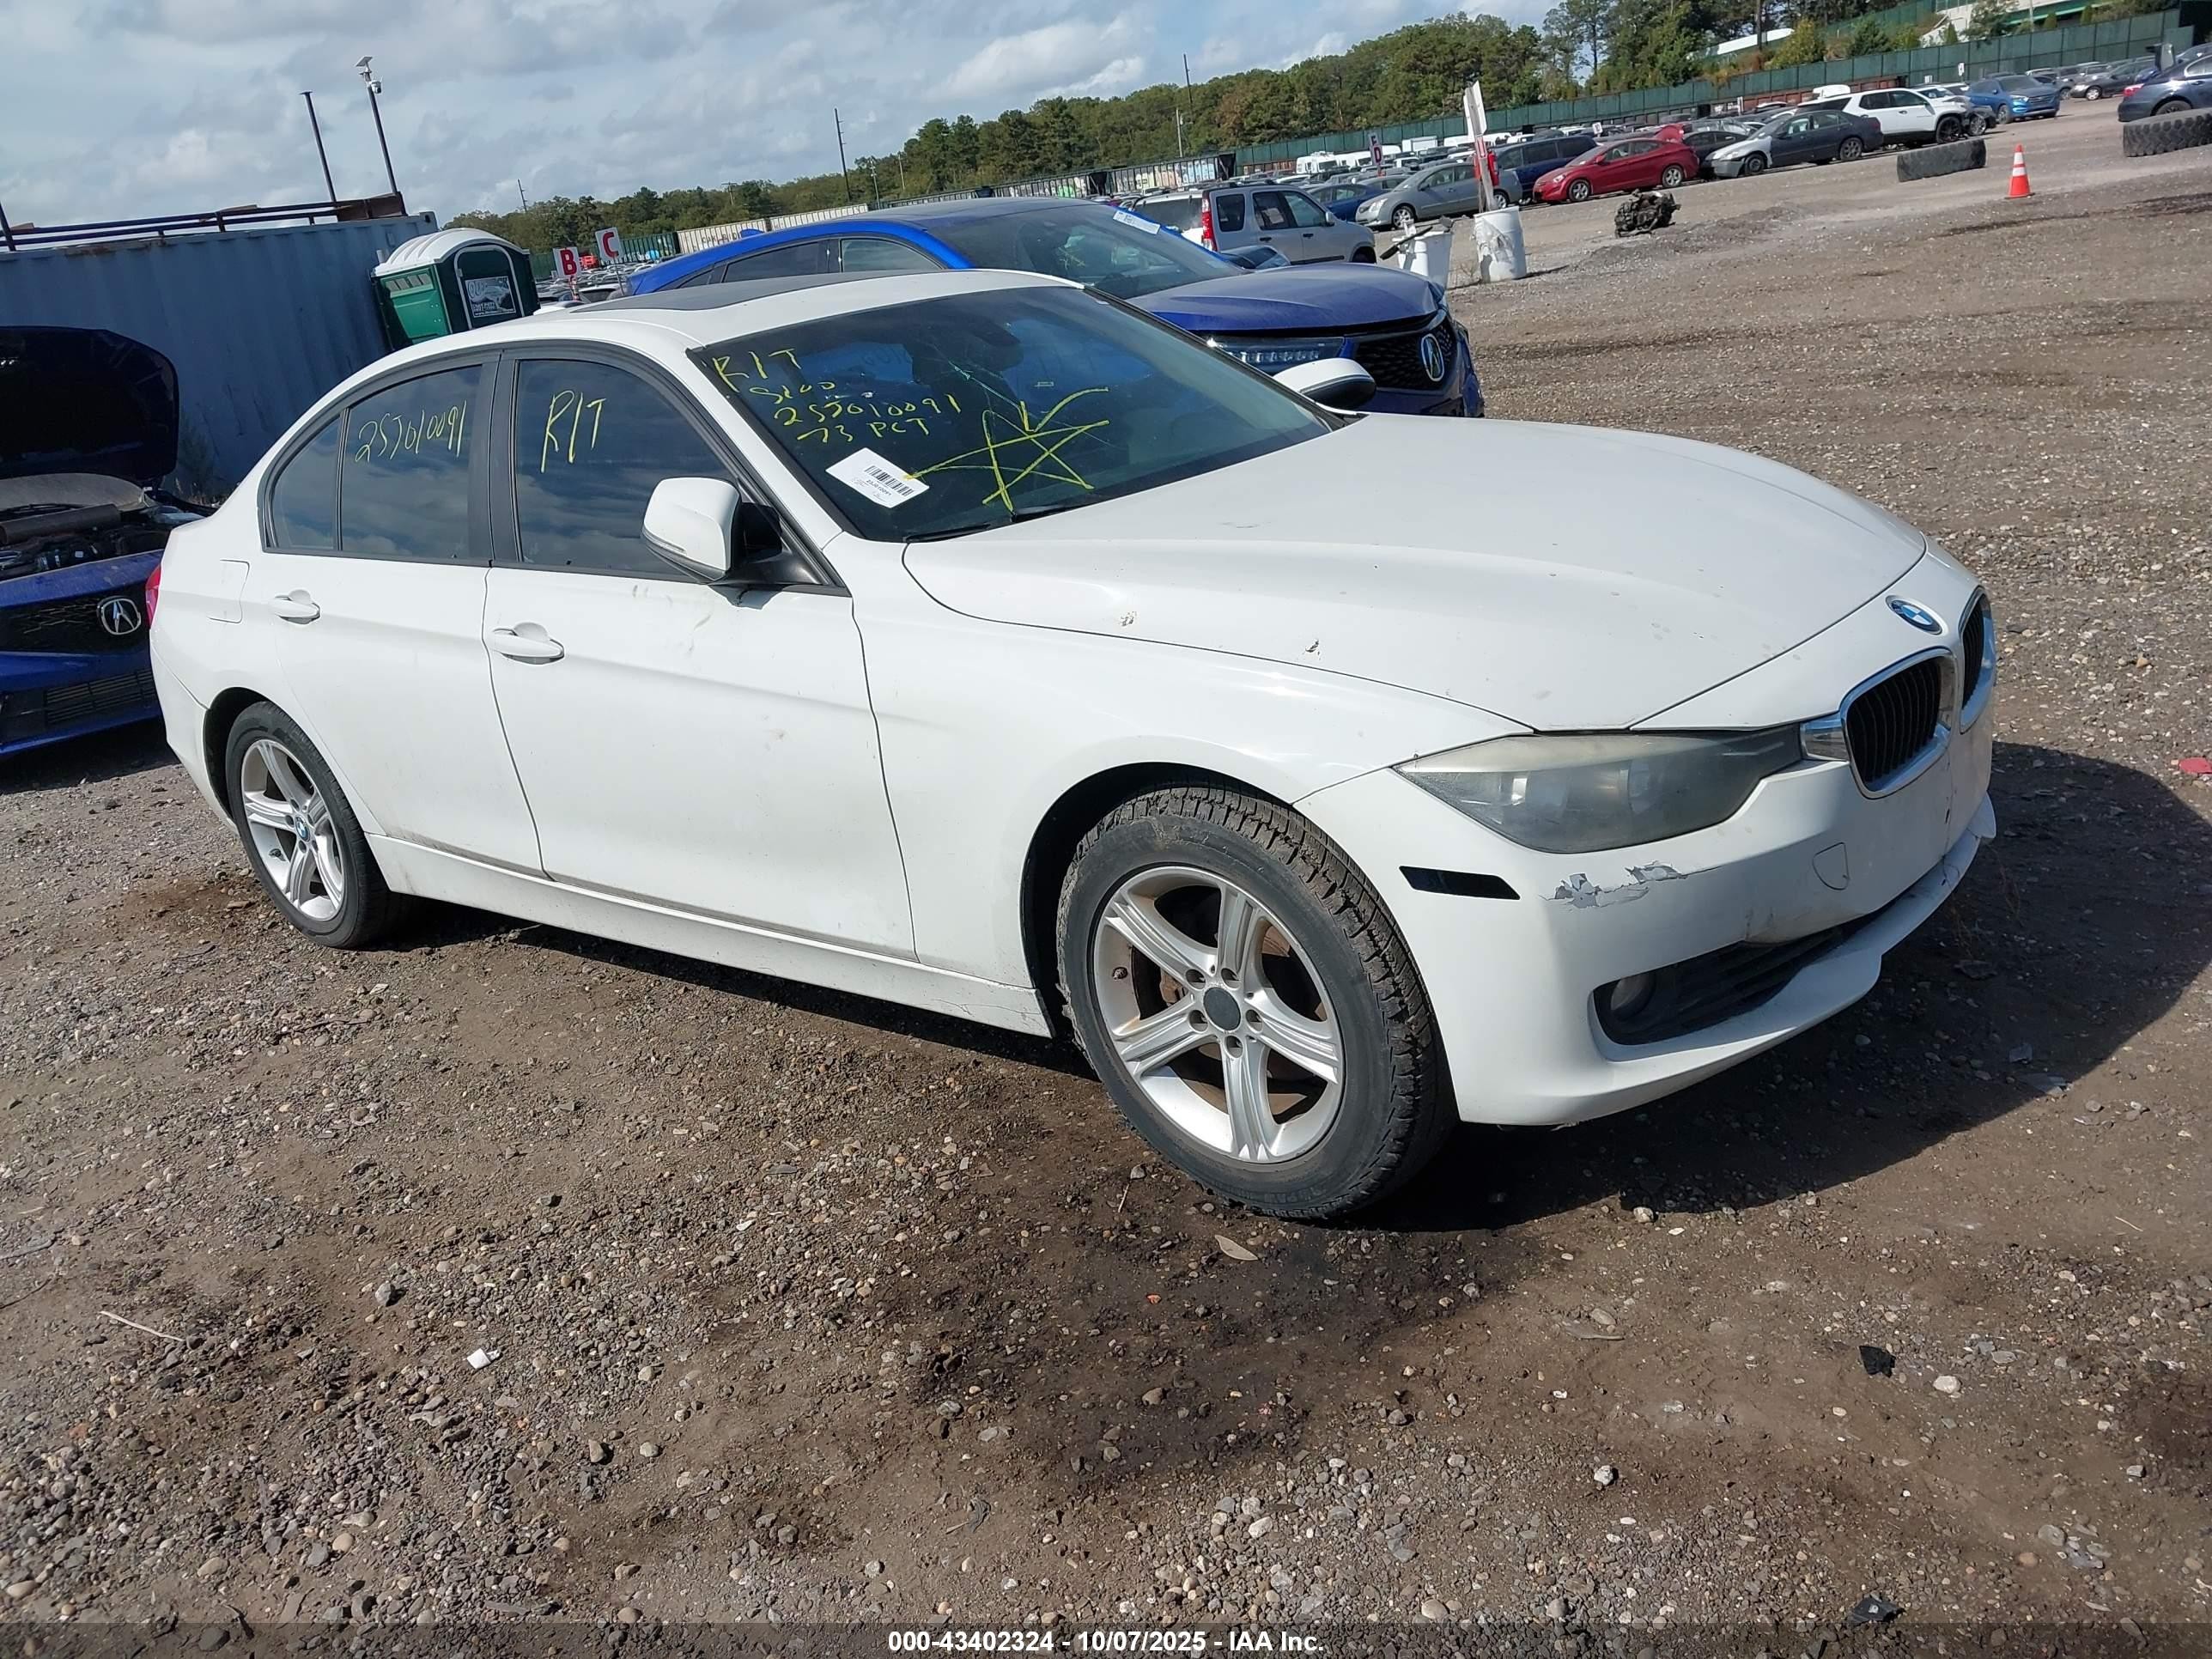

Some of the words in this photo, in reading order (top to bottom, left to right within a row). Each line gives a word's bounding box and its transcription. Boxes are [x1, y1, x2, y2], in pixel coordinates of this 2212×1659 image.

[603, 231, 619, 258] C
[560, 249, 577, 275] B
[866, 417, 929, 438] PCT
